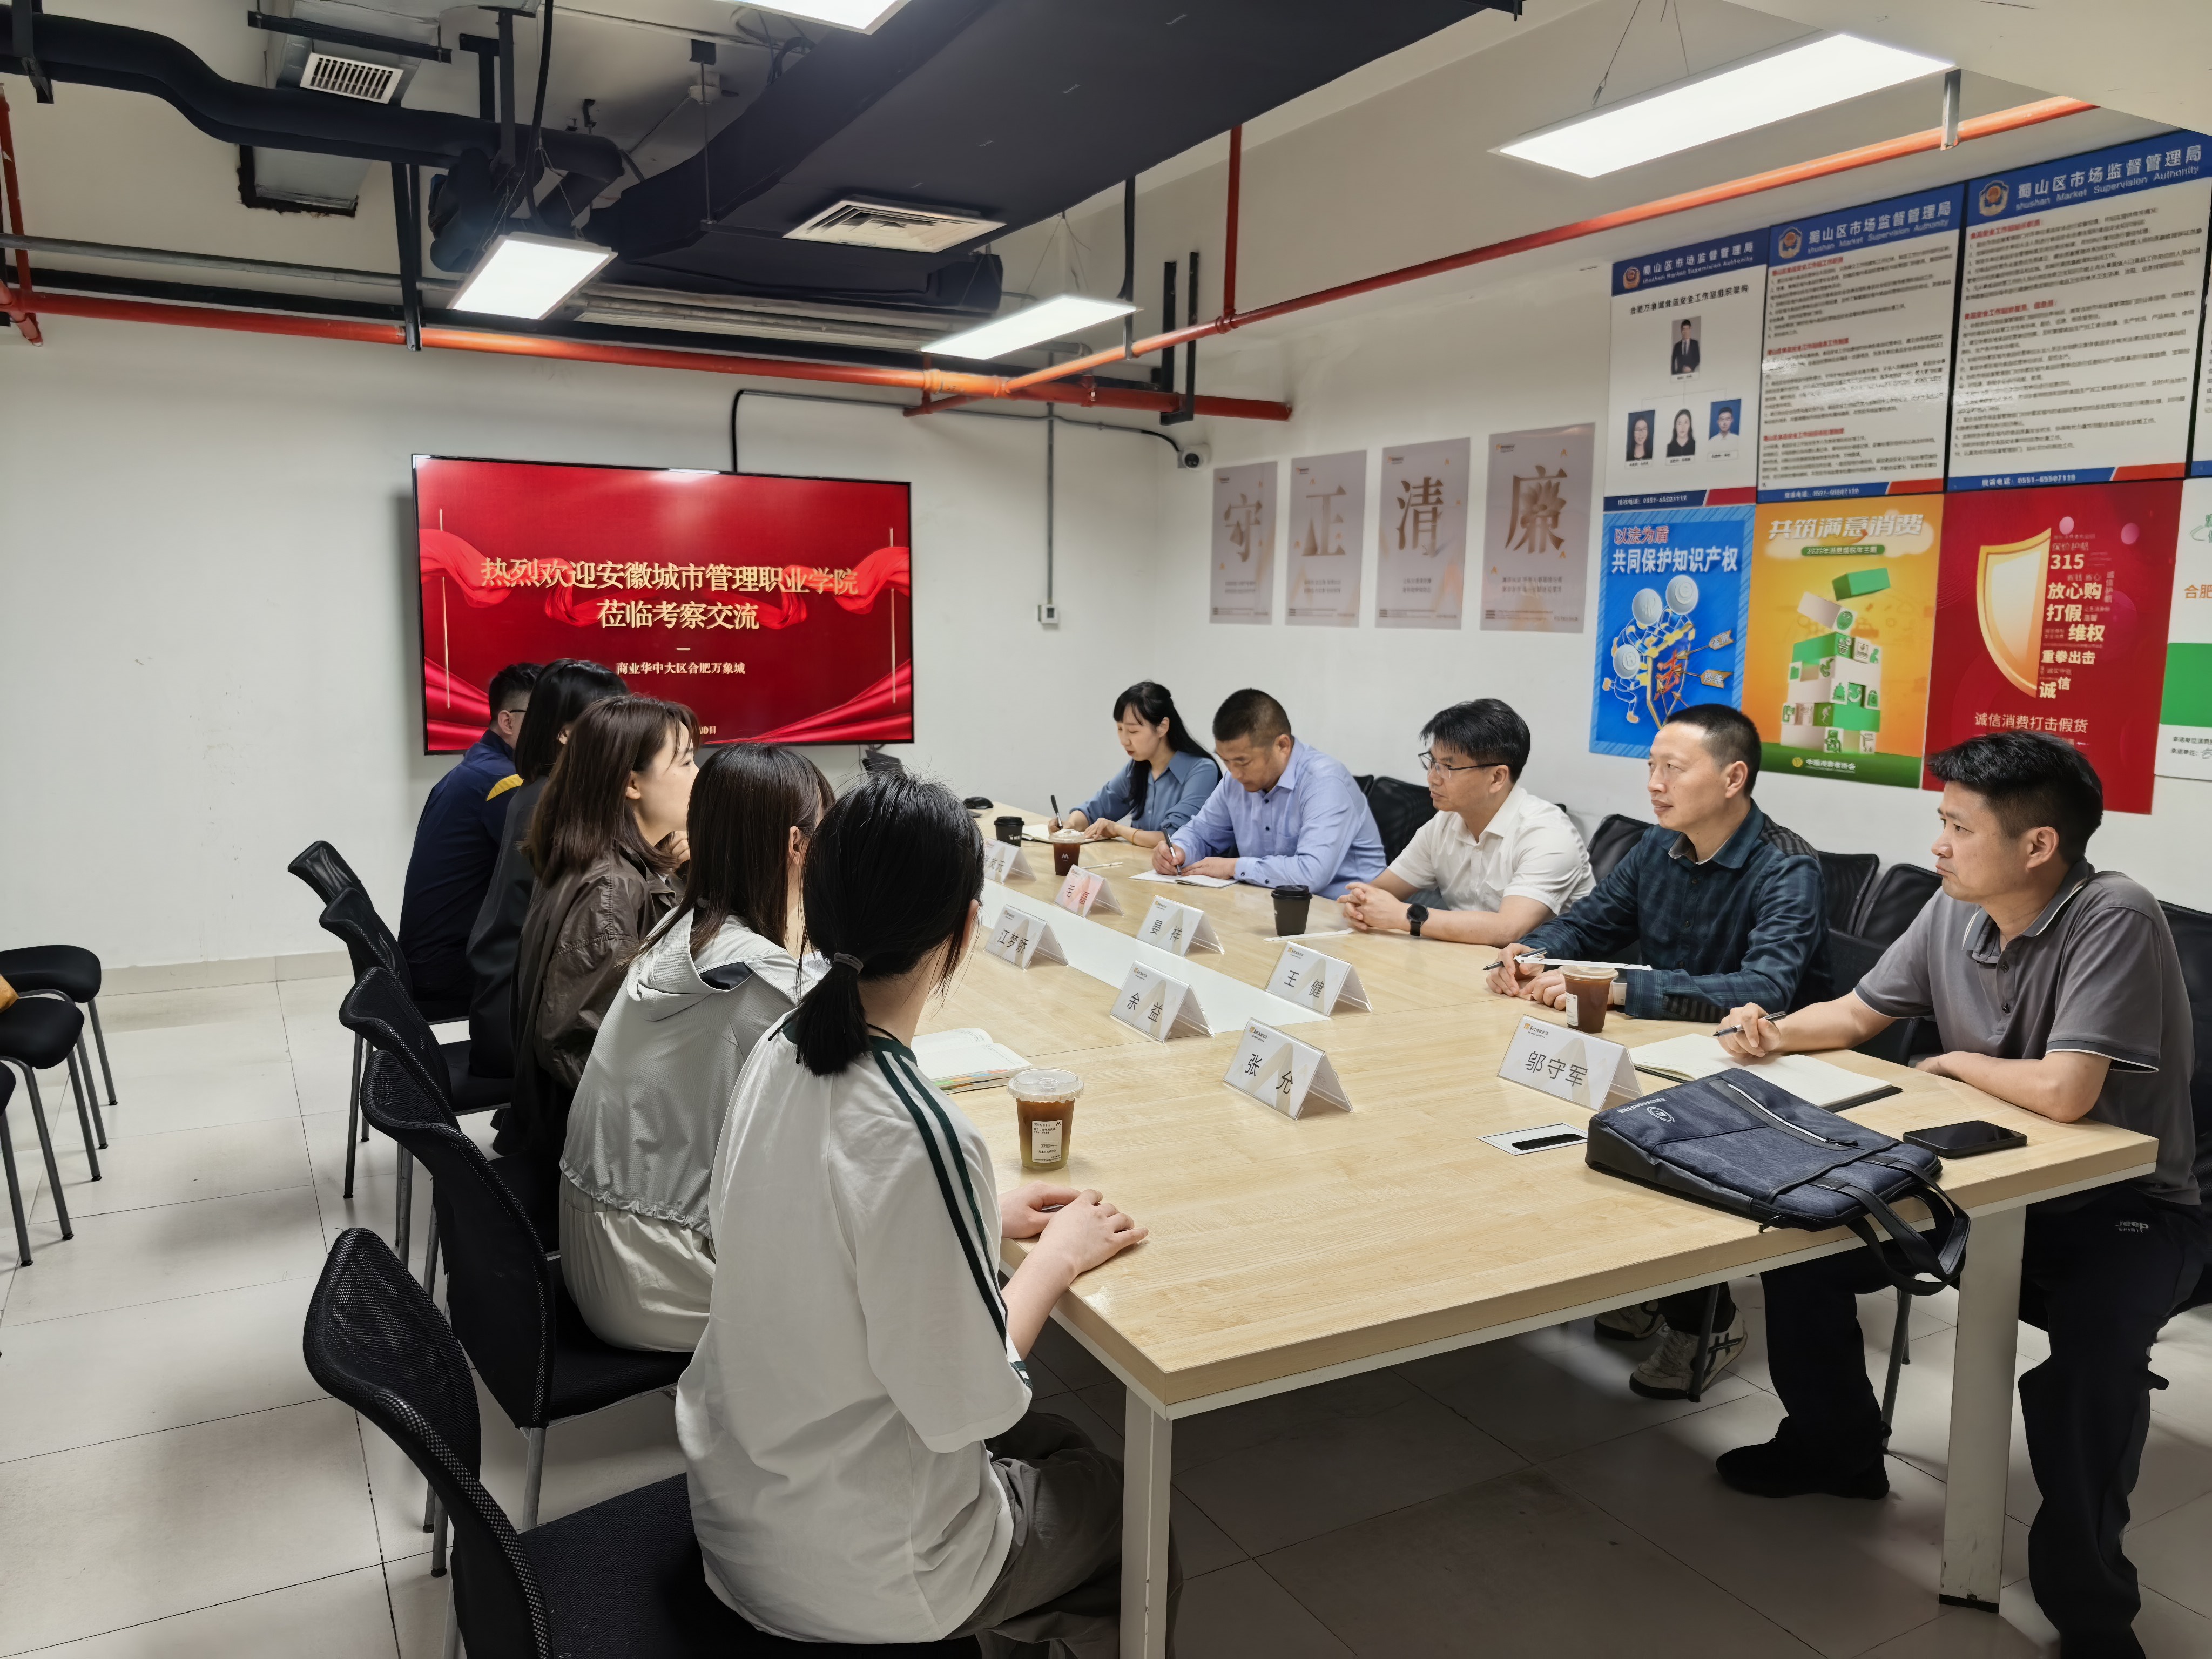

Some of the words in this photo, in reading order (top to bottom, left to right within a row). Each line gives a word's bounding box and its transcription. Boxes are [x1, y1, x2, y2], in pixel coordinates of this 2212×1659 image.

[2018, 145, 2201, 199] 蜀山区市场监督管理局
[1809, 201, 1951, 244] 蜀山区市场监督管理局
[1301, 485, 1347, 557] 正
[1396, 476, 1444, 557] 清
[1505, 464, 1568, 554] 廉
[1224, 493, 1262, 563] 守
[1614, 525, 1669, 545] 以法为盾
[1768, 514, 1924, 540] 共筑满意消费
[1611, 545, 1738, 574] 共同保护知识产权
[2051, 554, 2085, 569] 315
[480, 557, 859, 595] 热烈欢迎安徽城市管理职业学院
[2047, 582, 2102, 599] 放心购
[597, 601, 759, 630] 莅临考察交流
[2047, 604, 2082, 622] 打假
[2068, 624, 2105, 642] 维权
[616, 662, 745, 675] 商业华中大区合肥万象城
[2041, 650, 2095, 664] 重拳出击
[1975, 712, 2088, 733] 诚信消费打击假货
[997, 928, 1029, 954] 江梦娇
[1284, 970, 1324, 998] 王健
[1127, 992, 1163, 1022] 余益
[1245, 1054, 1293, 1094] 张允
[1525, 1050, 1588, 1087] 邬守军
